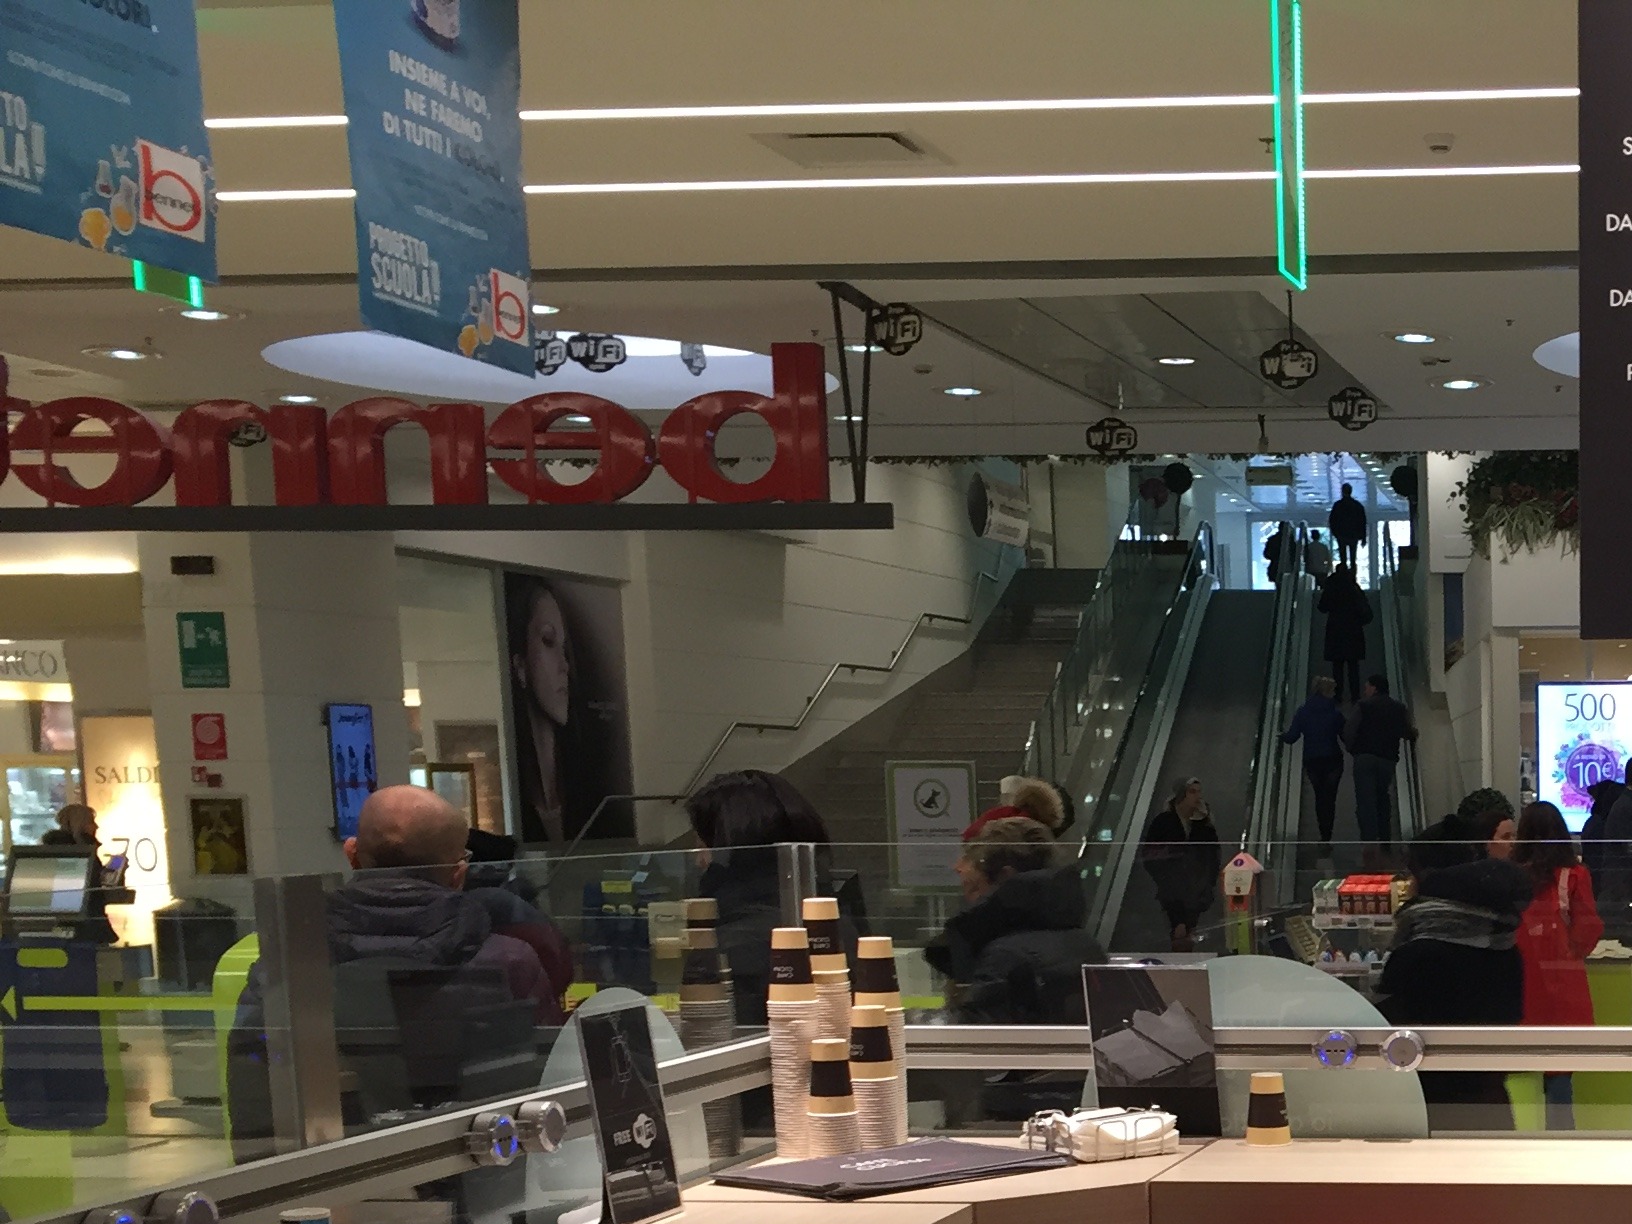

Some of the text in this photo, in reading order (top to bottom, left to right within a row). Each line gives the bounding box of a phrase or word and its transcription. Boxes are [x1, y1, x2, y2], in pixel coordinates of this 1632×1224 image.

[389, 50, 448, 96] INSIEME
[451, 81, 460, 102] A
[404, 88, 427, 117] NE
[382, 111, 401, 137] DI
[402, 119, 443, 154] TUTTI
[369, 221, 429, 267] PROGETTO
[371, 252, 440, 306] SCUOLA!
[1564, 693, 1616, 721] 500
[613, 1129, 632, 1147] FREE
